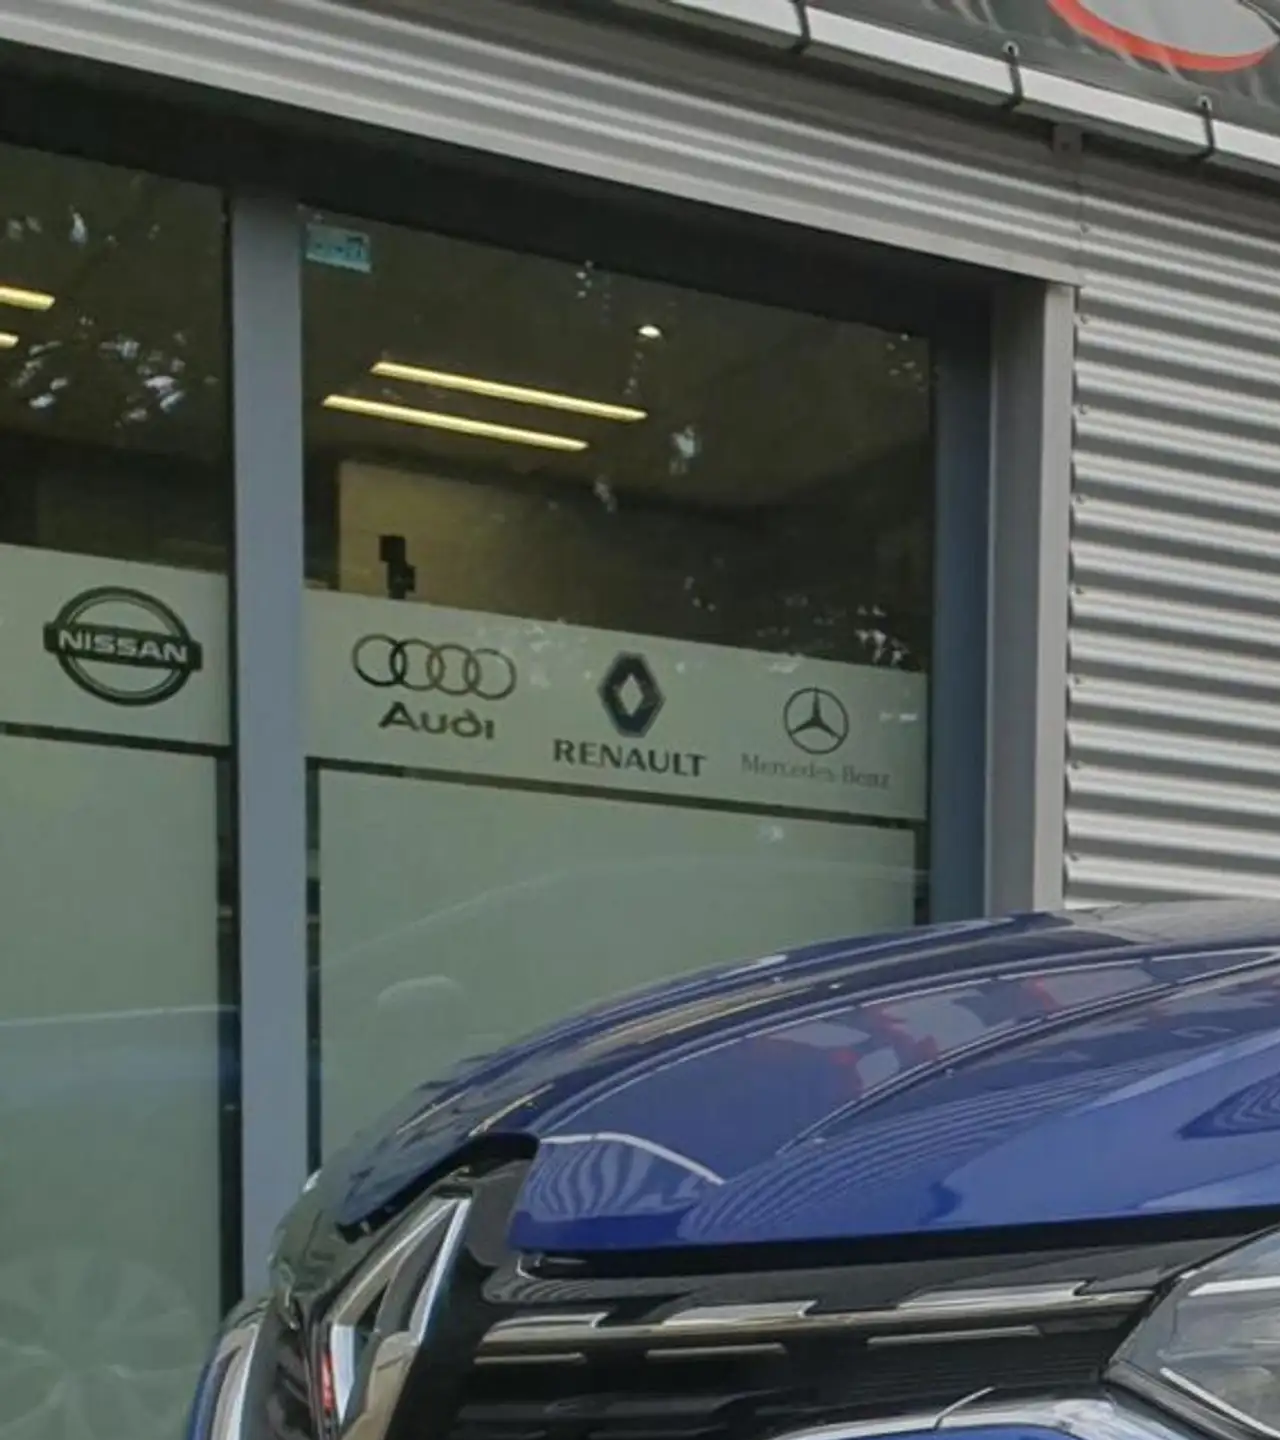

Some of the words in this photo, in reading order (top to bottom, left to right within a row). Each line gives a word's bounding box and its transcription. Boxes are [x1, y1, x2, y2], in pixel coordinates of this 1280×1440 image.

[58, 629, 189, 663] NISSAN
[377, 701, 496, 740] Audi
[552, 738, 706, 777] RENAULT
